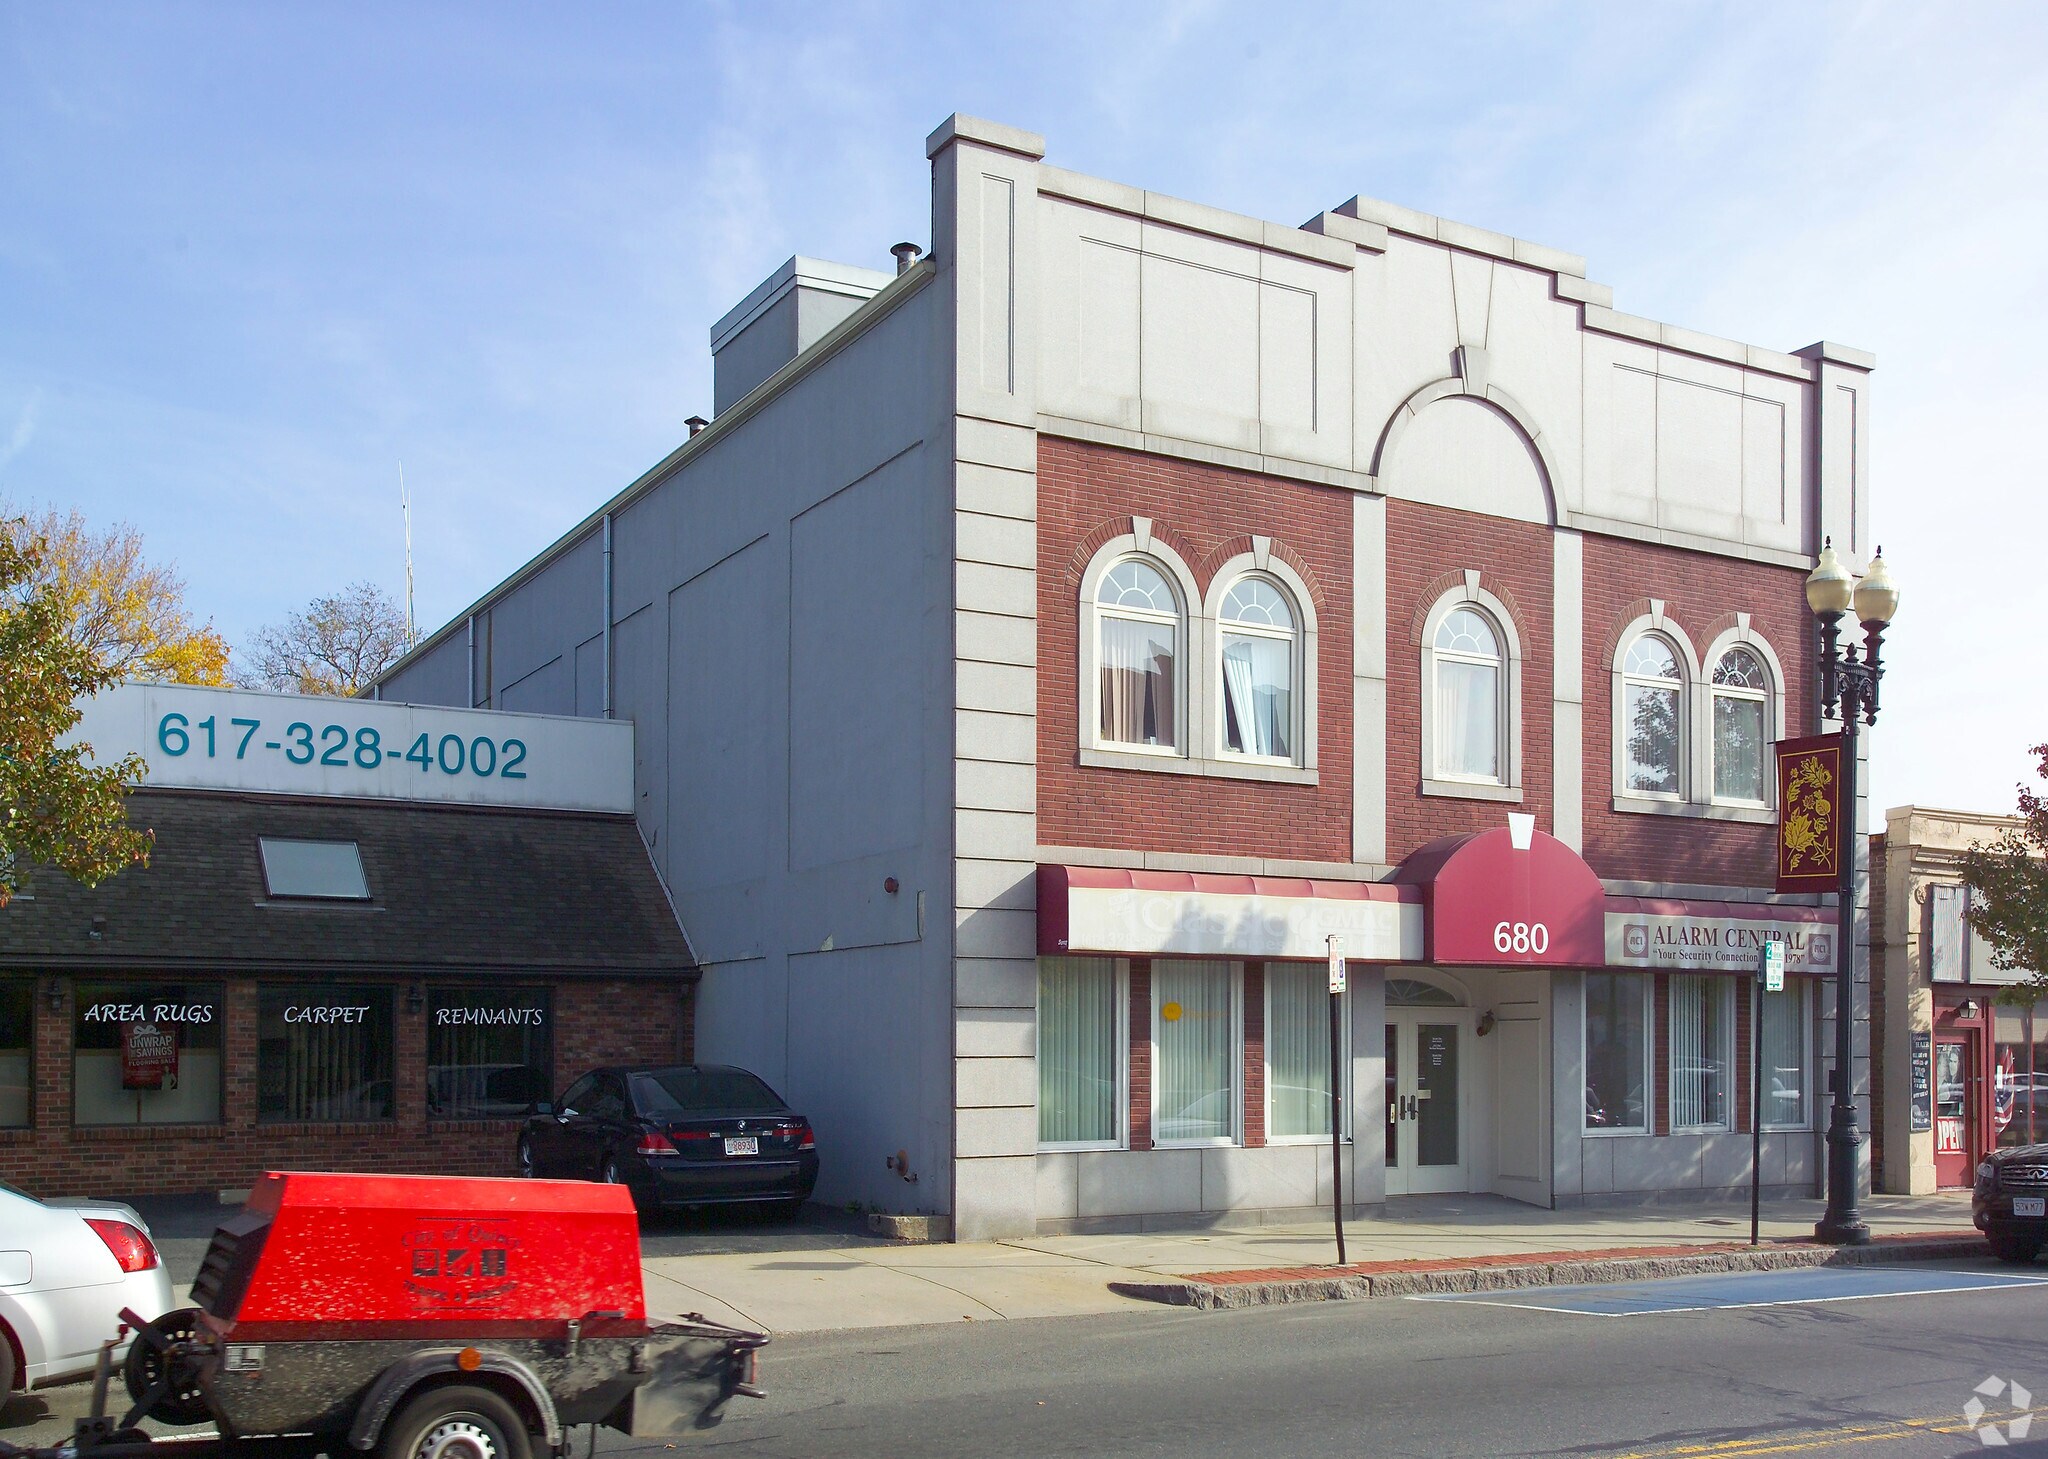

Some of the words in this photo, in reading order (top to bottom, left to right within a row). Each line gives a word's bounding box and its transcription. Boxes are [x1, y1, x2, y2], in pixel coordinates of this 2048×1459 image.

[158, 712, 527, 779] 617-328-4002
[1493, 921, 1549, 954] 680
[1653, 925, 1719, 947] ALARM
[1725, 928, 1806, 950] CENTRAL
[1679, 950, 1712, 964] Security
[1715, 950, 1758, 963] Connection
[84, 1003, 146, 1022] AREA
[153, 1004, 213, 1023] RUGS
[284, 1006, 370, 1024] CARPET
[436, 1007, 543, 1025] REMNANTS
[129, 1035, 173, 1049] UNWRAP
[136, 1046, 173, 1058] SAVINGS
